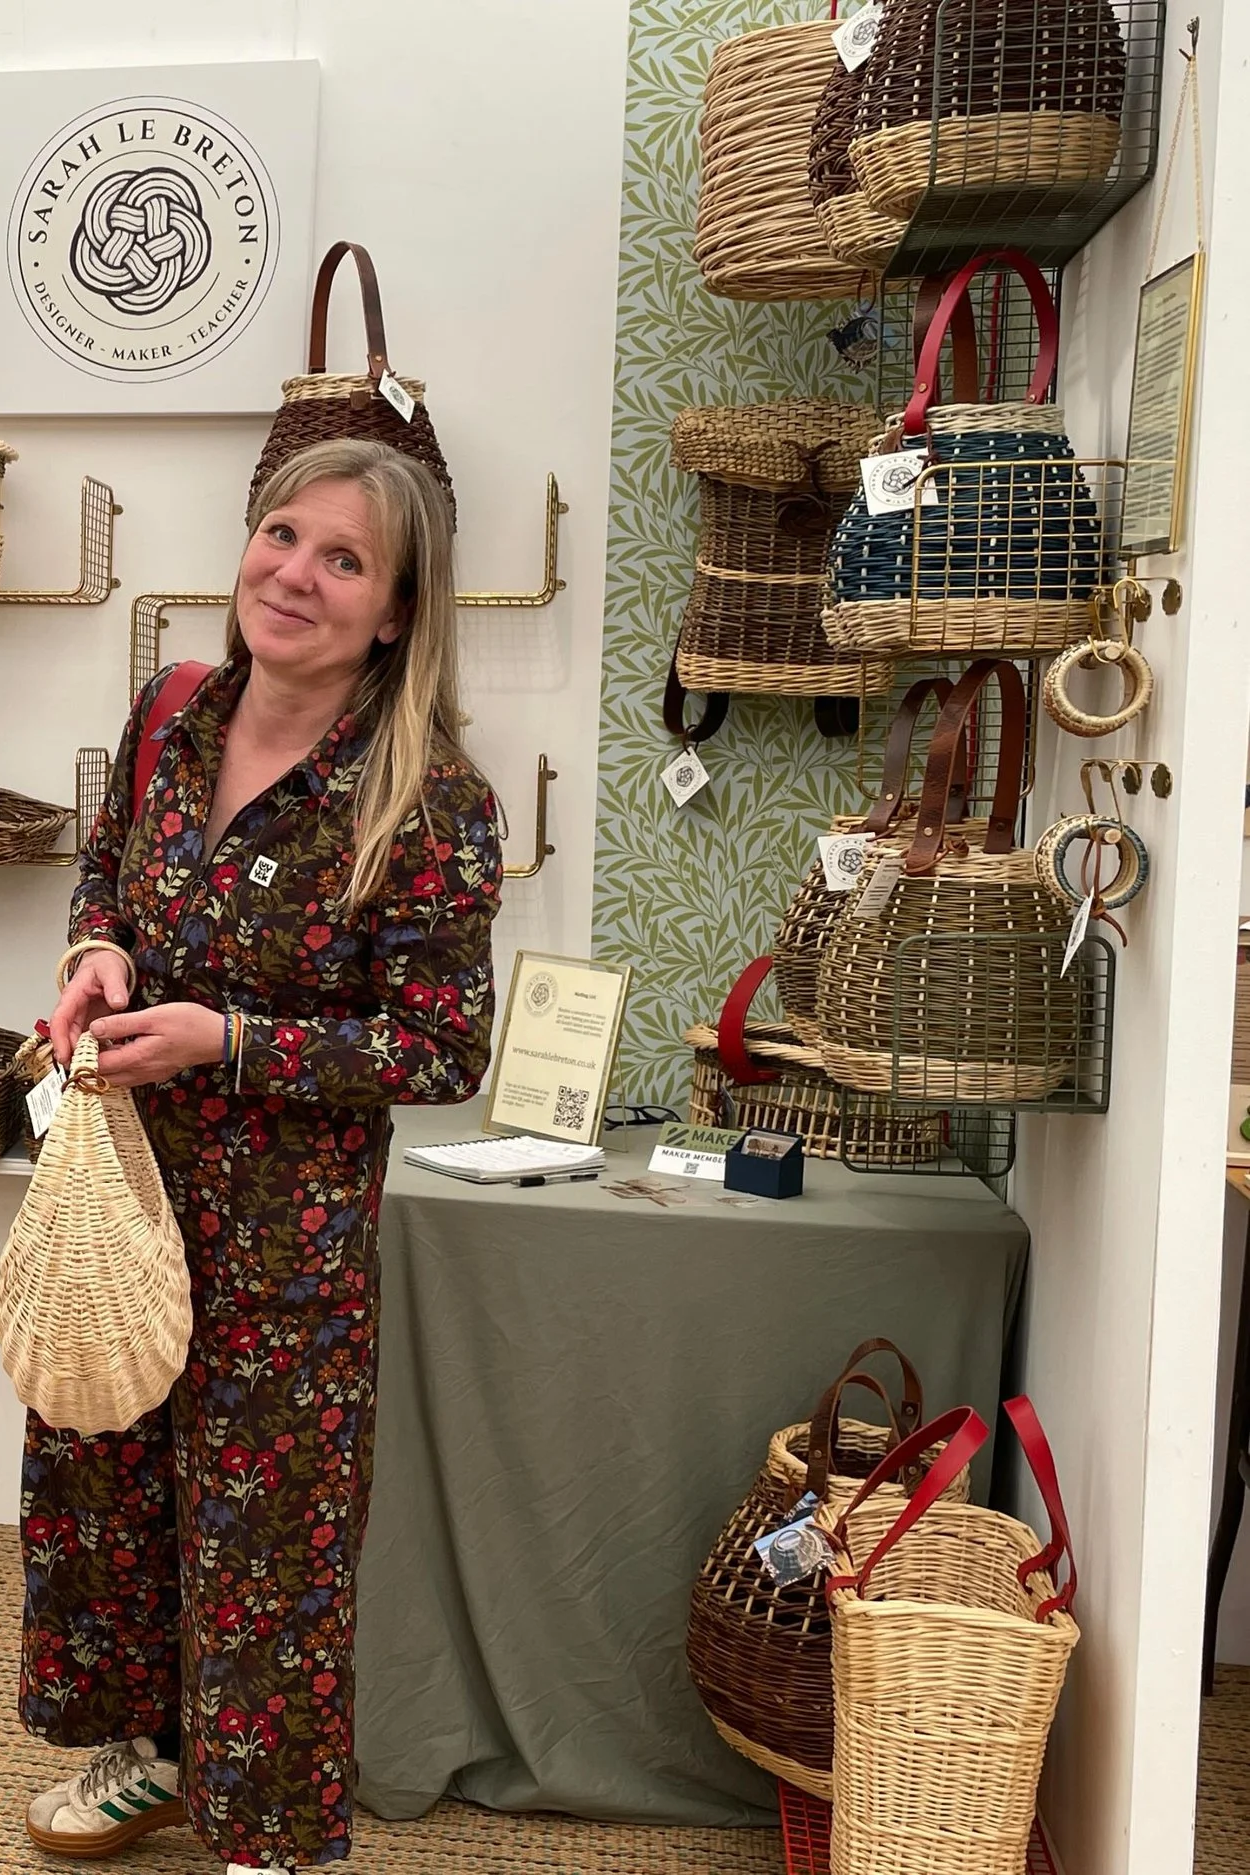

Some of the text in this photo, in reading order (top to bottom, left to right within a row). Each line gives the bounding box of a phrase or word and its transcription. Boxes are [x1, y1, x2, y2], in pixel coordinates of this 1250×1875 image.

[28, 119, 258, 244] SARAH LE BRETON
[34, 279, 248, 360] DESIGNER MAKER TEACHER
[512, 1046, 597, 1070] www.sarahlebreton.co.uk
[691, 1129, 738, 1146] MAKE
[662, 1149, 726, 1164] MAKER MEMBE
